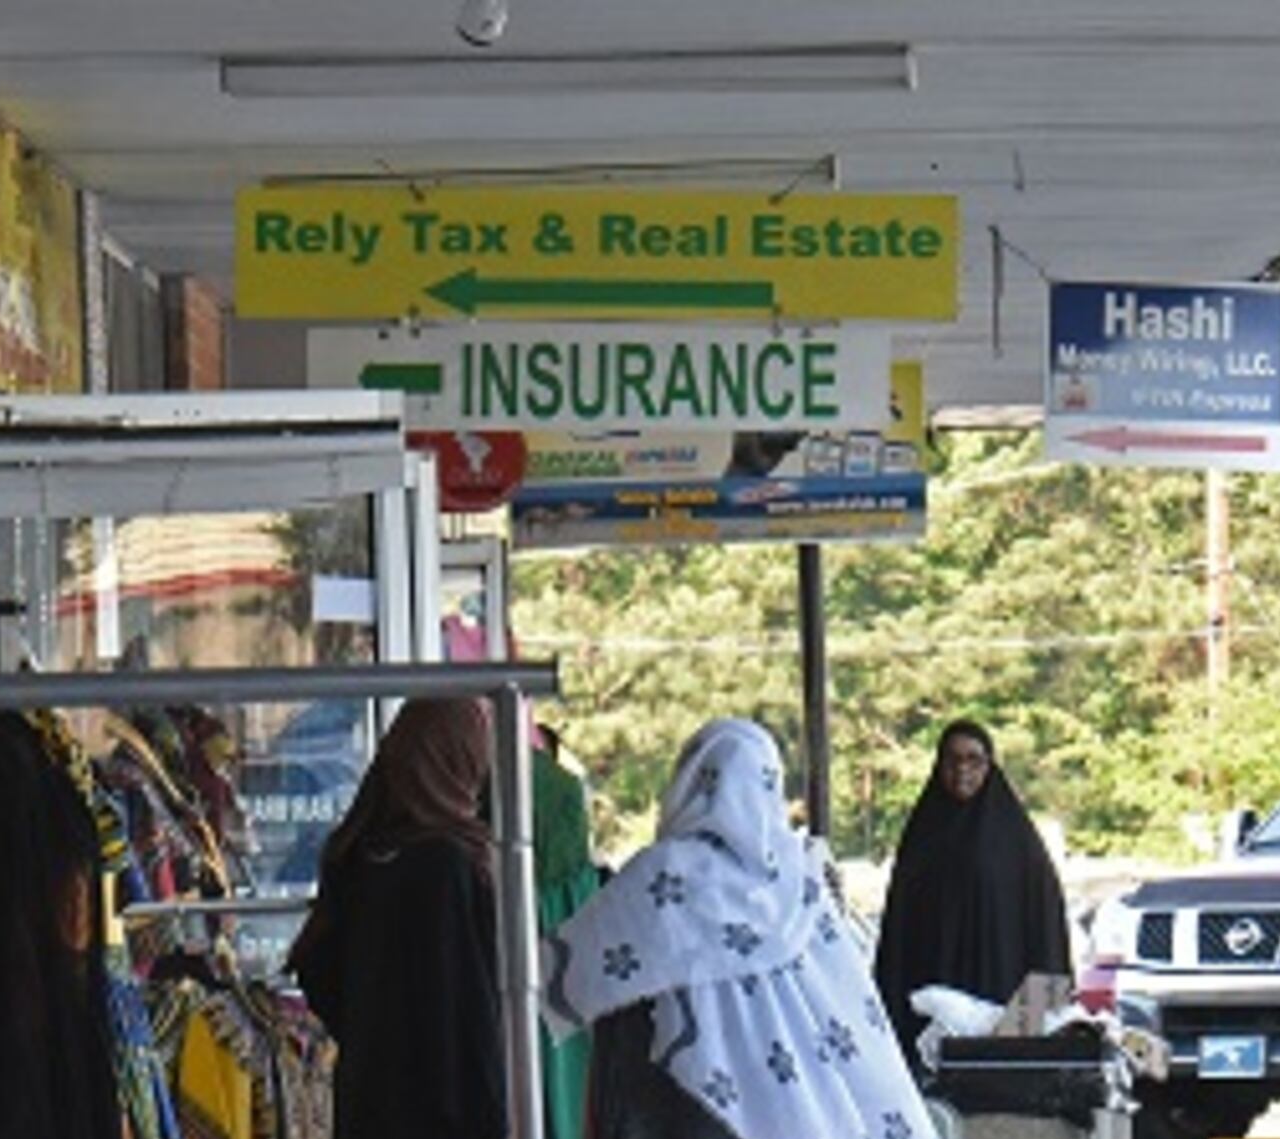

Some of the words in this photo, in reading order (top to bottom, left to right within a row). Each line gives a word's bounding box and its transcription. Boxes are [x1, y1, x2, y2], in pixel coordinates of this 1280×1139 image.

[255, 212, 381, 264] Rely
[403, 213, 509, 255] Tax
[533, 214, 574, 256] &
[600, 213, 727, 257] Real
[751, 214, 943, 258] Estate
[1104, 291, 1236, 341] Hashi
[461, 342, 840, 418] INSURANCE
[1226, 352, 1277, 376] LLC.
